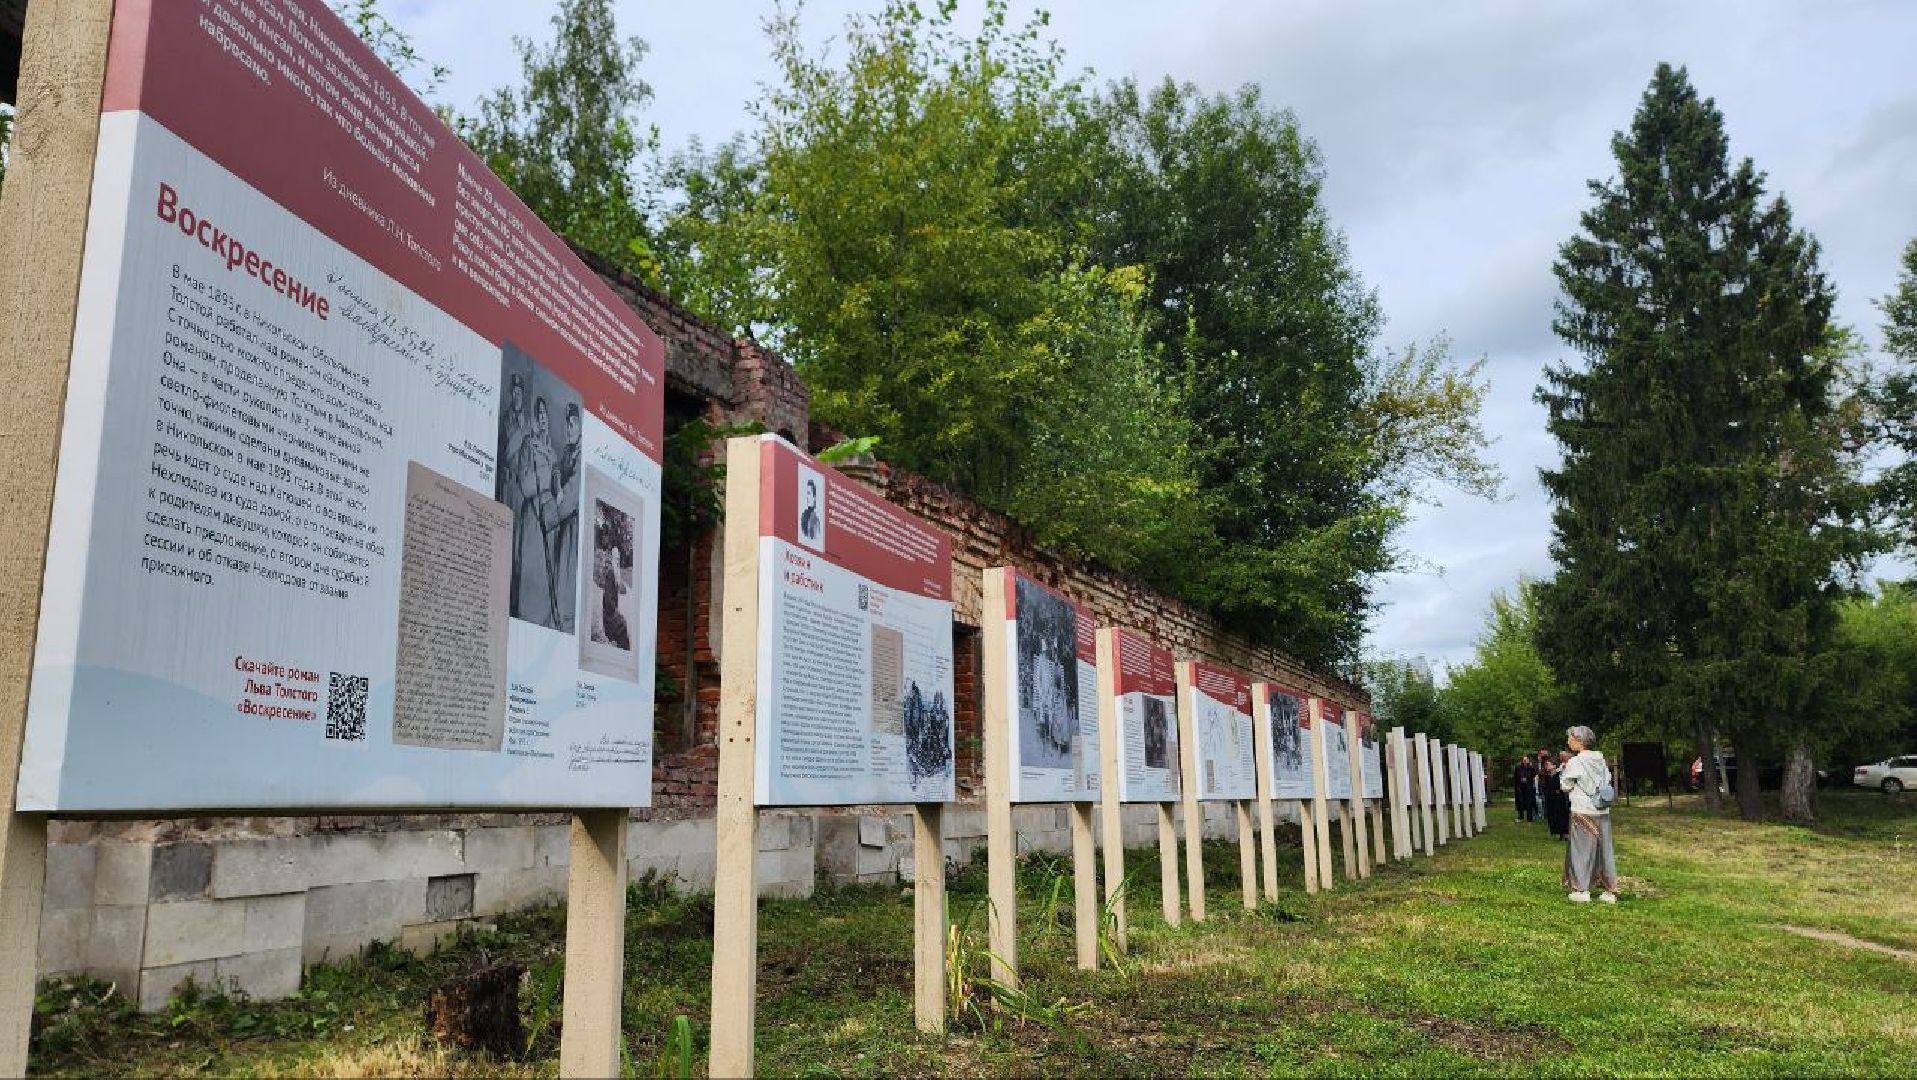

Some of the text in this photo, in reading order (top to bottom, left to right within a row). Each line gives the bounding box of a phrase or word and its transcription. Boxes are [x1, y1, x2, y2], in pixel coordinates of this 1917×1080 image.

[200, 16, 270, 85] набросано.
[214, 4, 274, 62] довольно
[277, 59, 314, 101] много,
[316, 94, 332, 116] так
[335, 112, 352, 133] что
[240, 2, 256, 23] не
[259, 19, 295, 62] писал,
[307, 64, 340, 100] потом
[288, 19, 323, 62] Потом
[324, 59, 371, 109] захворал
[374, 81, 398, 114] 1895.
[323, 167, 337, 189] Из
[338, 184, 385, 227] дневника
[157, 181, 330, 321] Воскресение
[172, 264, 180, 279] В
[183, 274, 205, 294] мае
[208, 286, 234, 311] 1895
[165, 332, 218, 368] романом,
[168, 307, 176, 323] С
[178, 316, 234, 353] точностью
[237, 348, 271, 372] можно
[171, 285, 213, 319] Толстой
[216, 315, 258, 344] работал
[260, 341, 278, 357] над
[280, 349, 321, 378] романом
[160, 375, 274, 433] светло-фиолетовыми
[163, 351, 186, 372] Она
[211, 376, 240, 396] части
[243, 392, 288, 420] рукописи
[156, 419, 164, 432] в
[166, 422, 233, 458] Никольском
[246, 458, 265, 472] мае
[268, 463, 291, 483] 1895
[159, 397, 194, 423] точно,
[197, 414, 236, 439] какими
[239, 433, 281, 458] сделаны
[151, 462, 217, 497] Нехлюдова
[220, 491, 233, 502] из
[235, 495, 258, 511] суда
[153, 442, 181, 462] речь
[213, 465, 221, 477] о
[223, 469, 246, 486] суде
[249, 479, 267, 496] над
[146, 511, 192, 534] сделать
[195, 526, 268, 558] предложение,
[148, 488, 156, 499] к
[159, 491, 220, 520] родителям
[222, 513, 270, 538] девушки,
[141, 557, 213, 585] присяжного.
[144, 533, 184, 552] сессии
[187, 547, 195, 556] и
[198, 548, 212, 562] об
[215, 554, 250, 573] отказе
[253, 562, 306, 588] Нехлюдова
[235, 656, 319, 682] Скачайте роман
[244, 679, 318, 702] Льва Толстого
[238, 699, 316, 720] «Воскресение»
